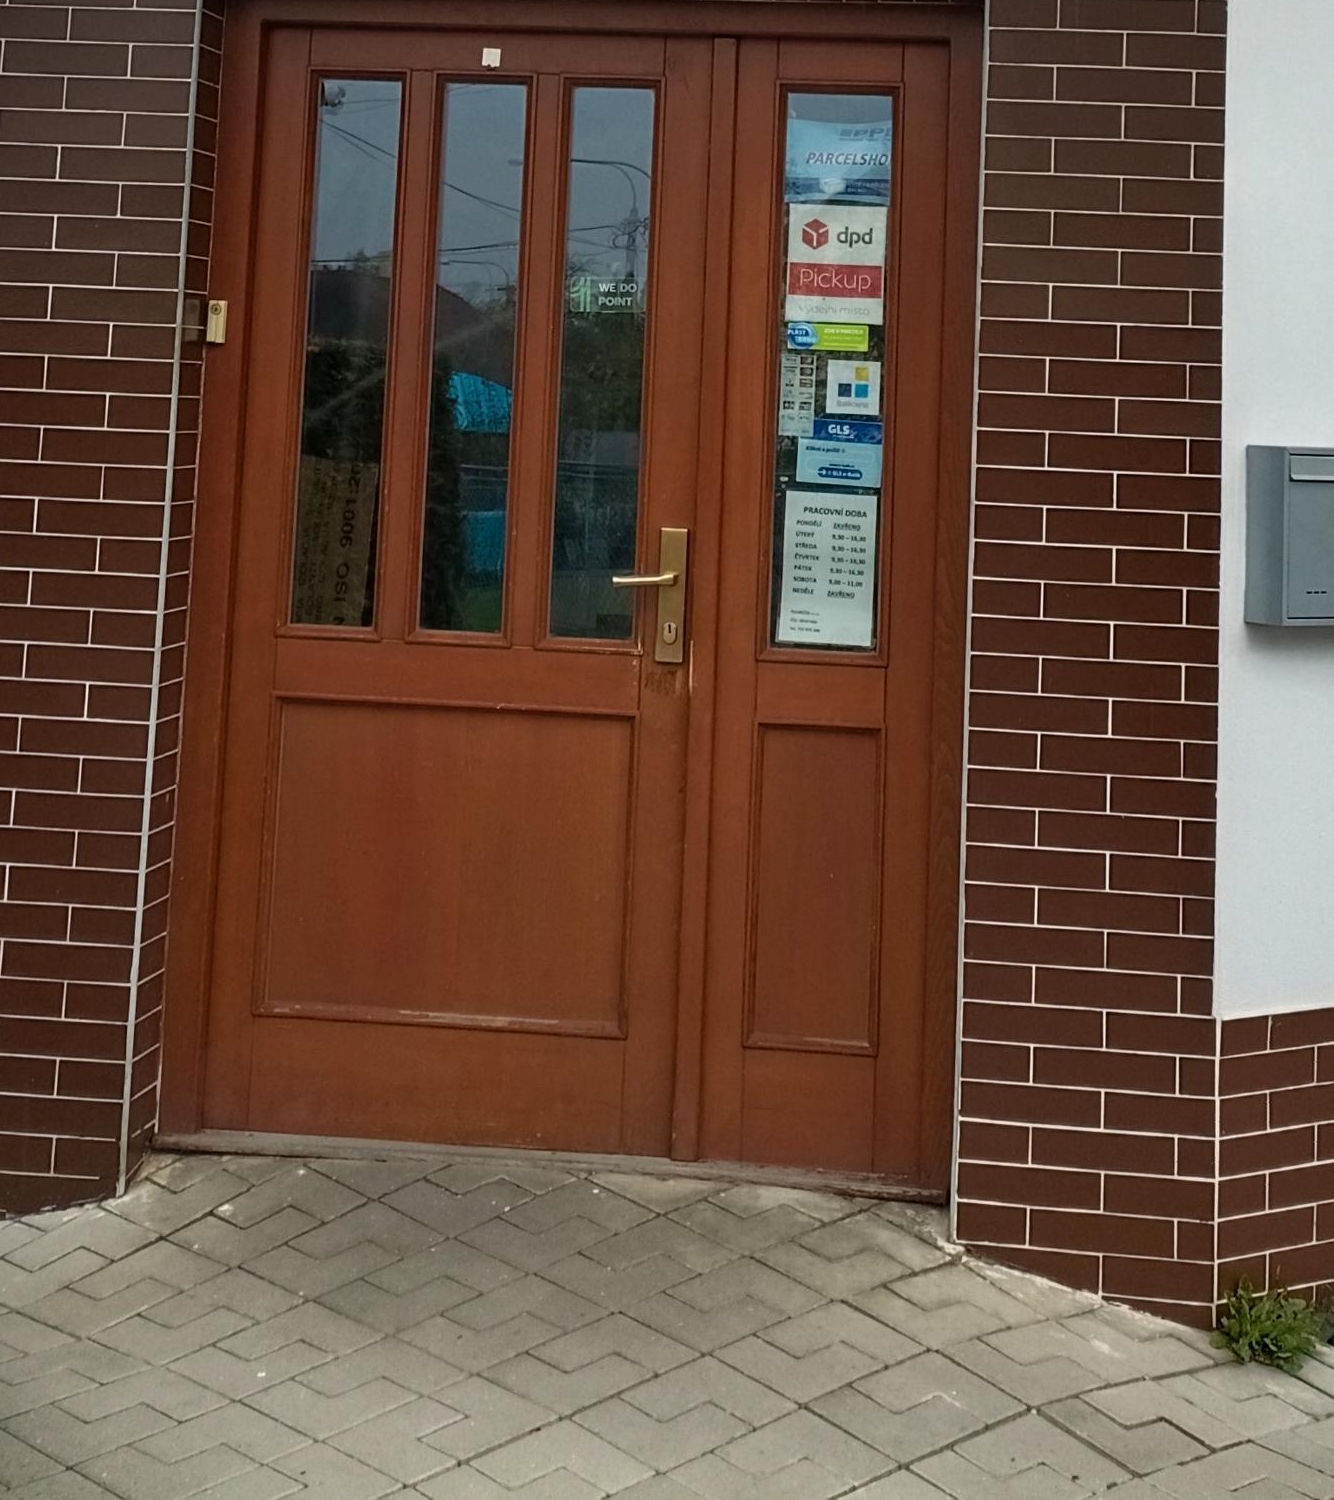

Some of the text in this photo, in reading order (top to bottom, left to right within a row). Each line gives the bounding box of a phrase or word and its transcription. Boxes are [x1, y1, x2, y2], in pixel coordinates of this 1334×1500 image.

[837, 226, 873, 248] dpd
[800, 268, 872, 293] Pickup
[598, 283, 638, 293] WE DO
[598, 296, 633, 307] POINT
[827, 424, 850, 435] GLS
[803, 506, 868, 518] PRACOVNÍ DOBA
[333, 562, 350, 602] ISO
